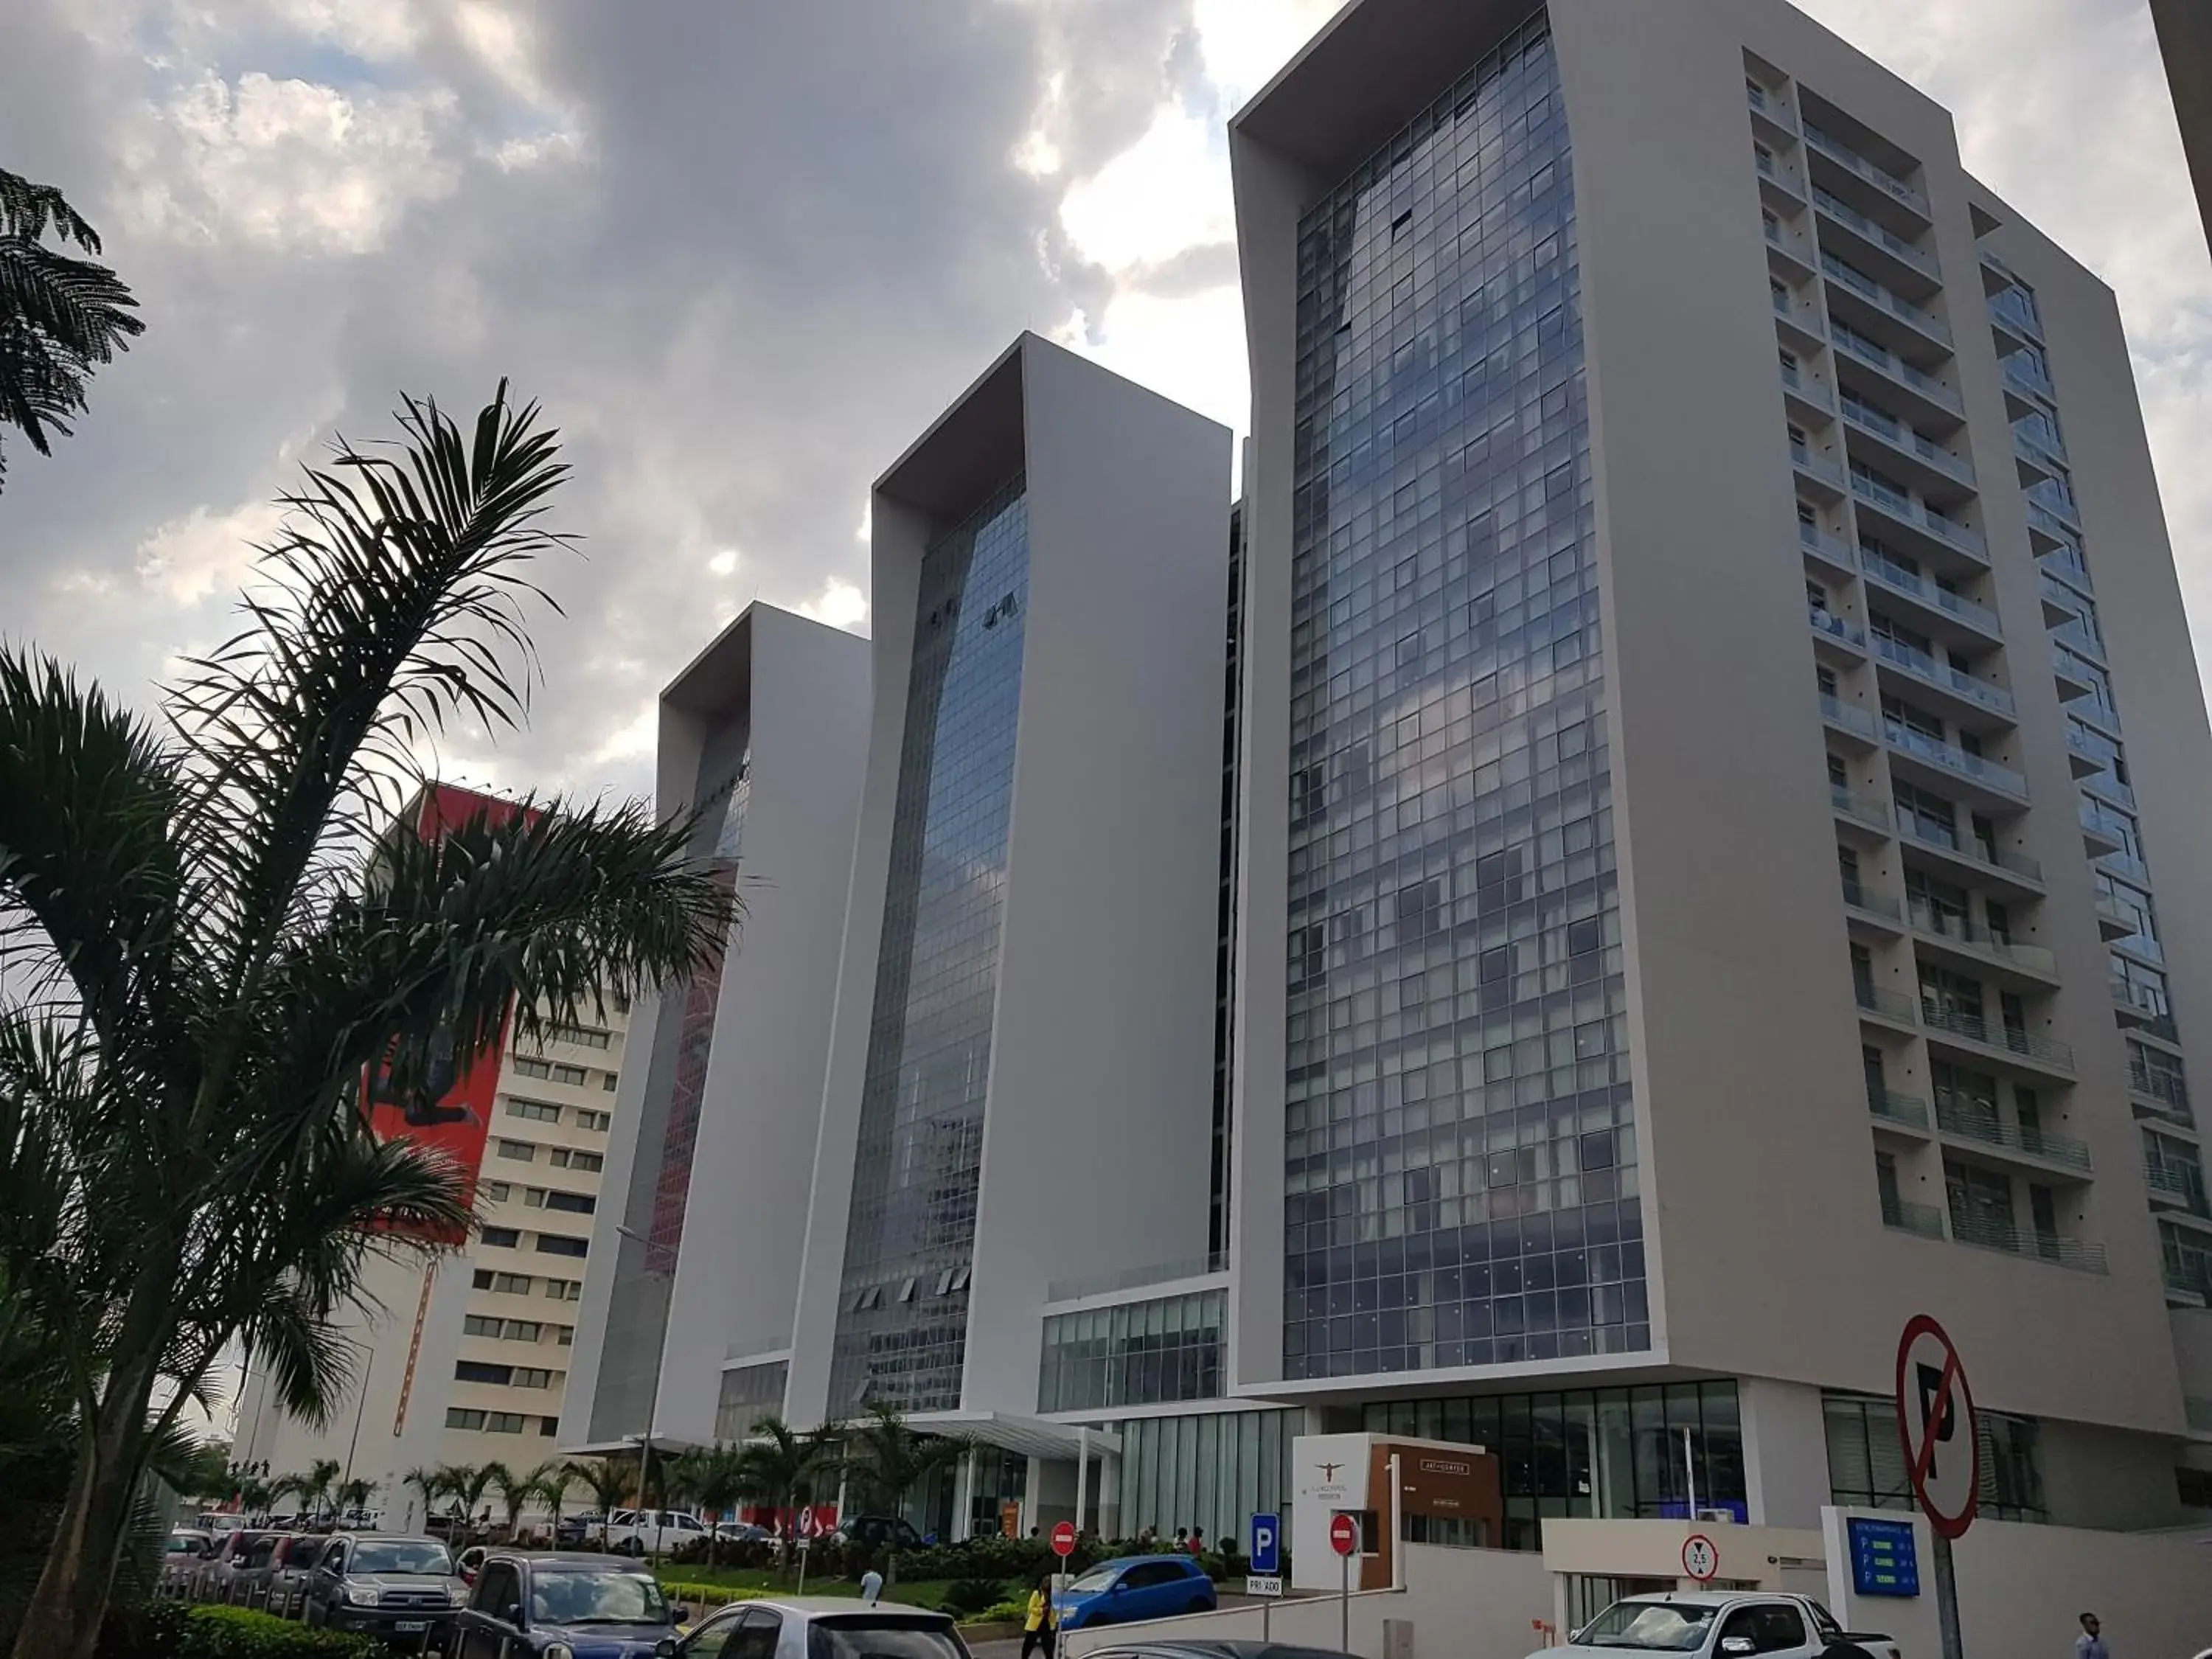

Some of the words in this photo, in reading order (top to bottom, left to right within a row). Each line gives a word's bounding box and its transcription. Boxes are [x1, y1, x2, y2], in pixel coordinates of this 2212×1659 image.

[1916, 1361, 1955, 1479] P
[1257, 1527, 1273, 1557] P
[1250, 1580, 1279, 1592] PRIADO
